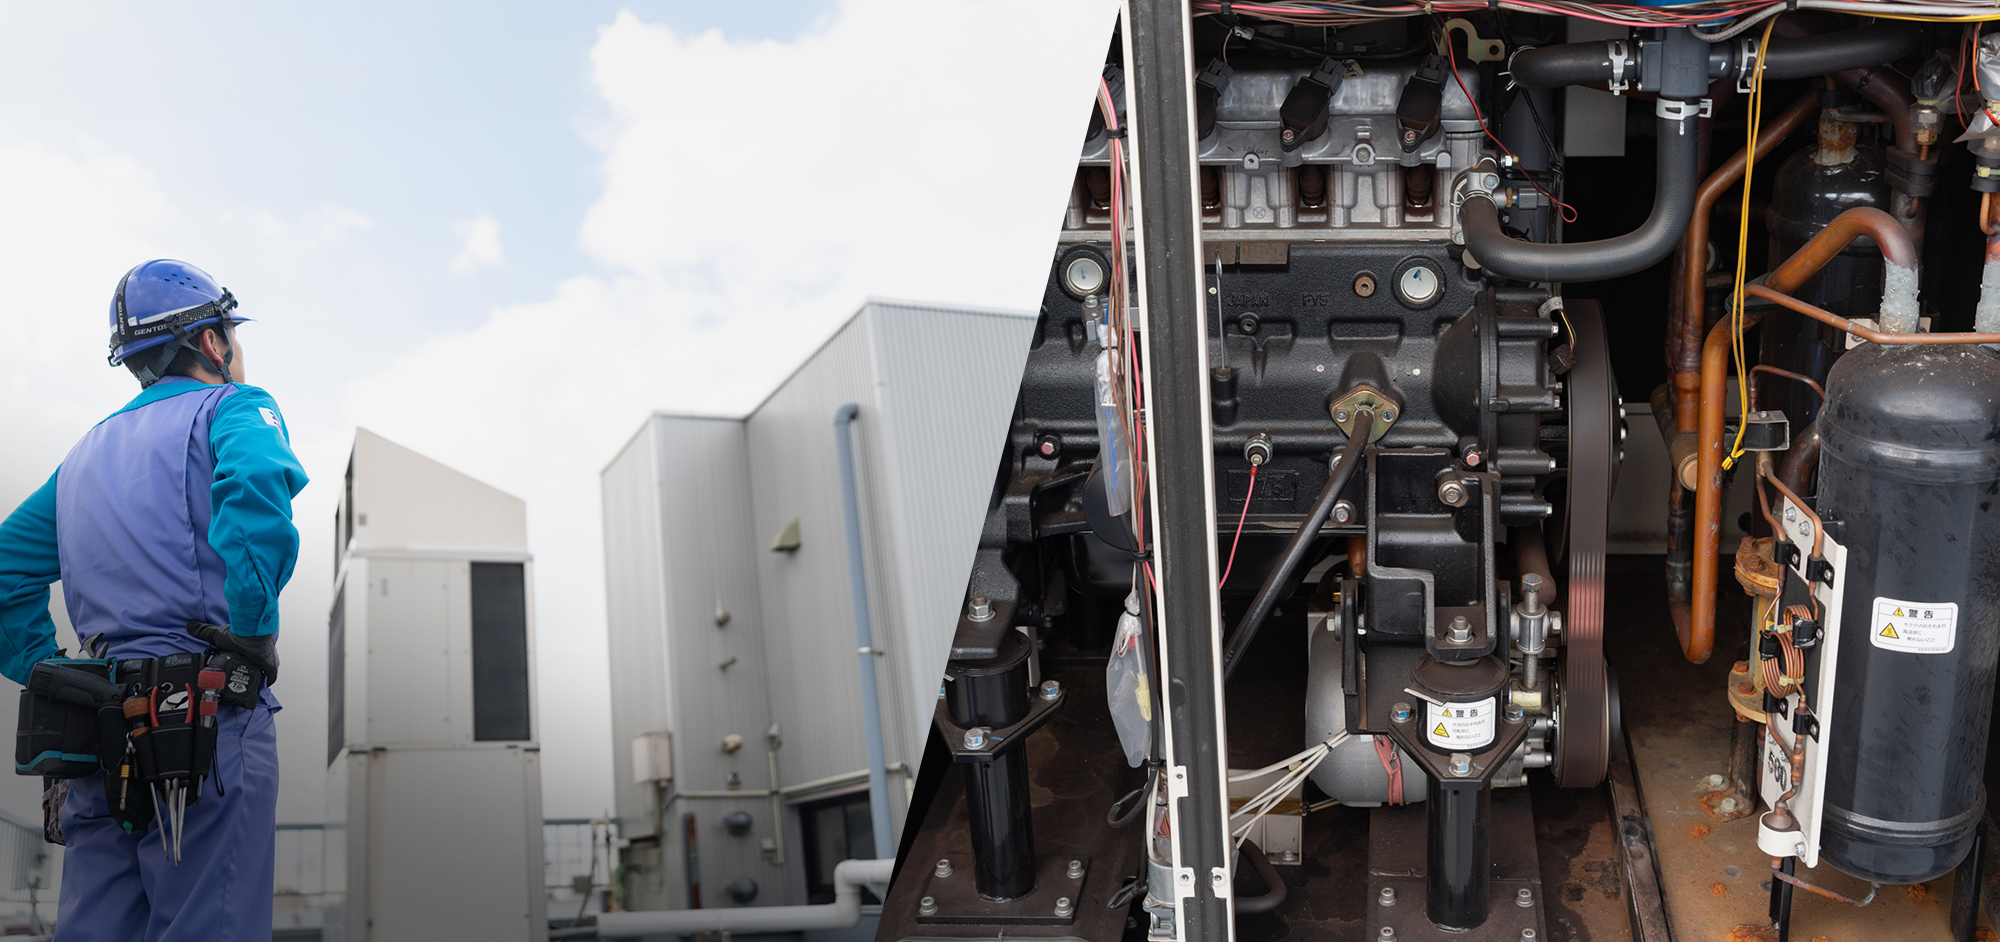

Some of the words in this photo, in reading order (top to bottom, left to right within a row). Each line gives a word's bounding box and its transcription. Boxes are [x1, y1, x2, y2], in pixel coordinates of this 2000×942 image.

[1227, 294, 1268, 307] JAPAN
[1908, 608, 1934, 619] 警告
[1455, 708, 1478, 718] 警告
